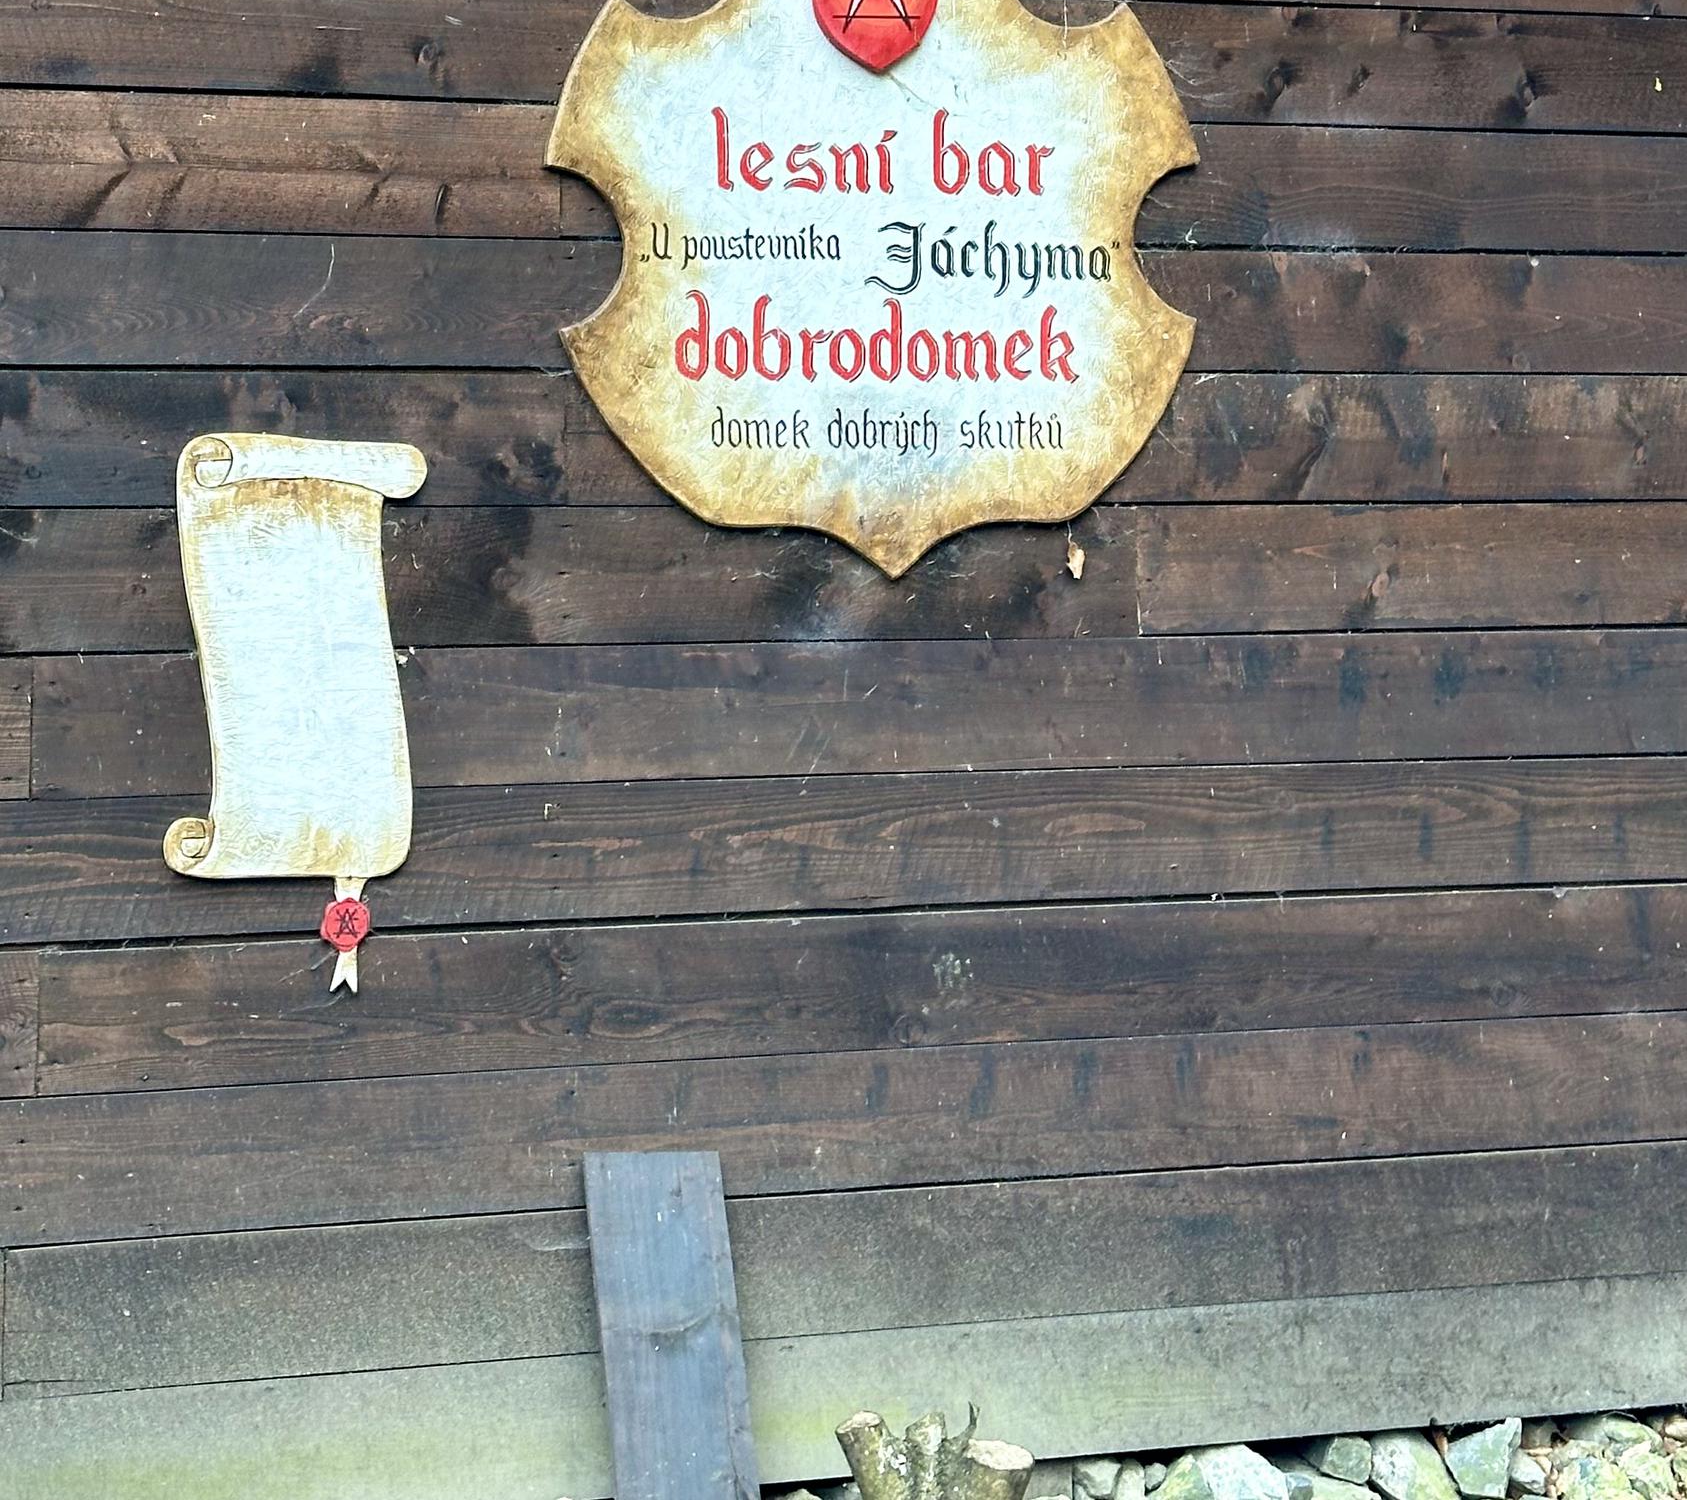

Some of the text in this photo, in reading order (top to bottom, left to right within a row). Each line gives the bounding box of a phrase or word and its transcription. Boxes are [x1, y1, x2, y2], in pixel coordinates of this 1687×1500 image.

[711, 106, 1054, 196] lesní bar
[681, 224, 842, 270] poustevníka
[674, 289, 1081, 383] dobrodomek
[711, 406, 1064, 457] domek dobrých skutků
